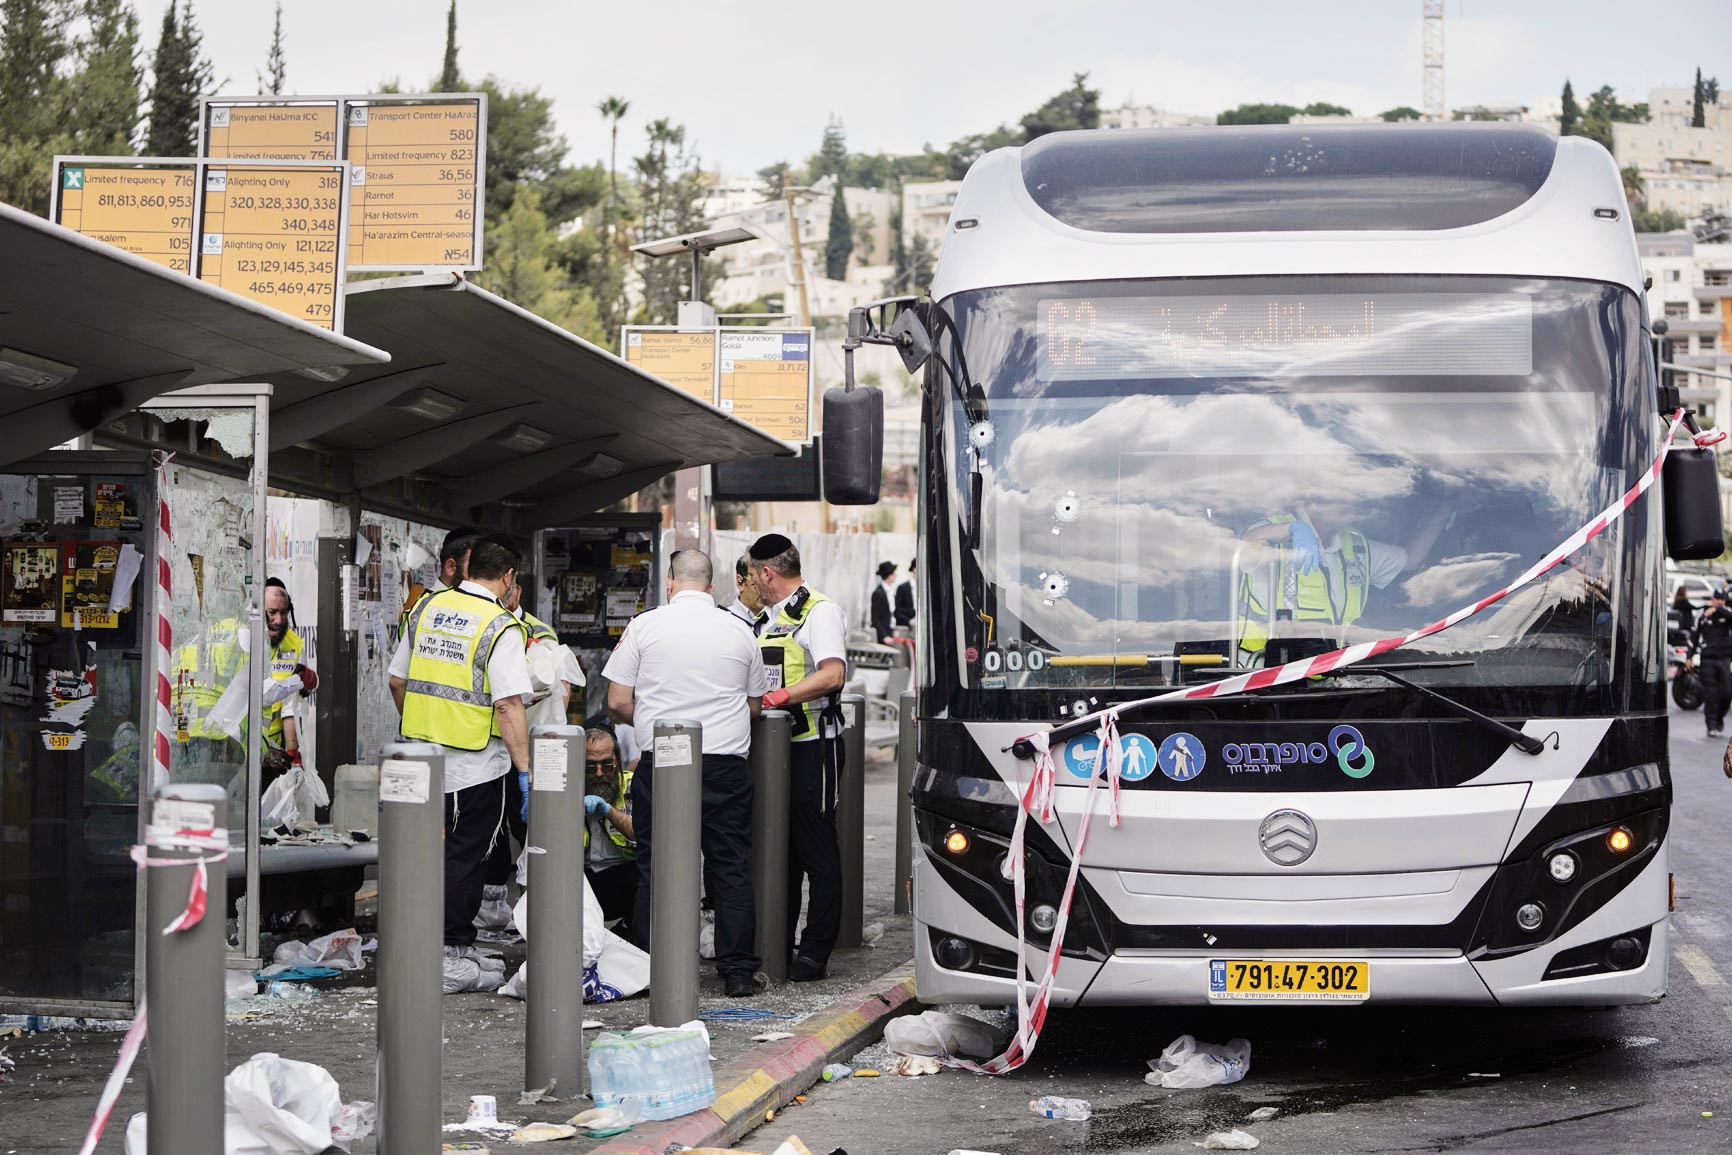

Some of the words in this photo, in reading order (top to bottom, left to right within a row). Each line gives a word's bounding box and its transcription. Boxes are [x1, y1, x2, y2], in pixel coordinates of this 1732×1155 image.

[231, 113, 267, 123] Binyanei
[269, 113, 300, 121] HaUma
[303, 113, 318, 121] ICC
[370, 112, 411, 121] Transport
[413, 111, 442, 120] Center
[314, 131, 334, 142] 541
[449, 129, 474, 140] 580
[311, 151, 334, 160] 756
[367, 152, 400, 160] Limited
[401, 151, 447, 161] frequency
[450, 149, 473, 160] 823
[84, 175, 118, 183] Limited
[120, 175, 166, 187] frequency
[174, 175, 194, 187] 716
[367, 171, 394, 179] Straus
[438, 169, 473, 182] 36,56
[227, 177, 267, 187] Alighting
[269, 178, 291, 187] Only
[318, 177, 338, 189] 318
[366, 192, 394, 200] Ramot
[457, 189, 472, 200] 36
[98, 194, 192, 209] 811,813,860,953
[230, 197, 337, 211] 320,328,330,338
[365, 212, 381, 220] Har
[382, 211, 419, 219] Hotsvim
[455, 209, 471, 220] 46
[171, 217, 191, 229] 971
[281, 219, 336, 233] 340,348
[364, 231, 409, 240] Ha'arazim
[169, 238, 190, 250] 105
[223, 241, 263, 251] Alighting
[265, 241, 286, 251] Only
[296, 240, 335, 254] 121,122
[169, 259, 188, 271] 221
[238, 260, 333, 275] 123,129,145,345
[249, 282, 332, 296] 465,469,475
[306, 304, 331, 316] 479
[1047, 301, 1096, 365] 62
[702, 362, 712, 371] 57
[704, 389, 712, 397] 61
[795, 403, 806, 411] 62
[789, 416, 806, 425] 506
[792, 430, 805, 438] 516
[1222, 742, 1328, 765] סופרבוס
[1227, 765, 1242, 774] דרך
[1214, 970, 1224, 983] IL
